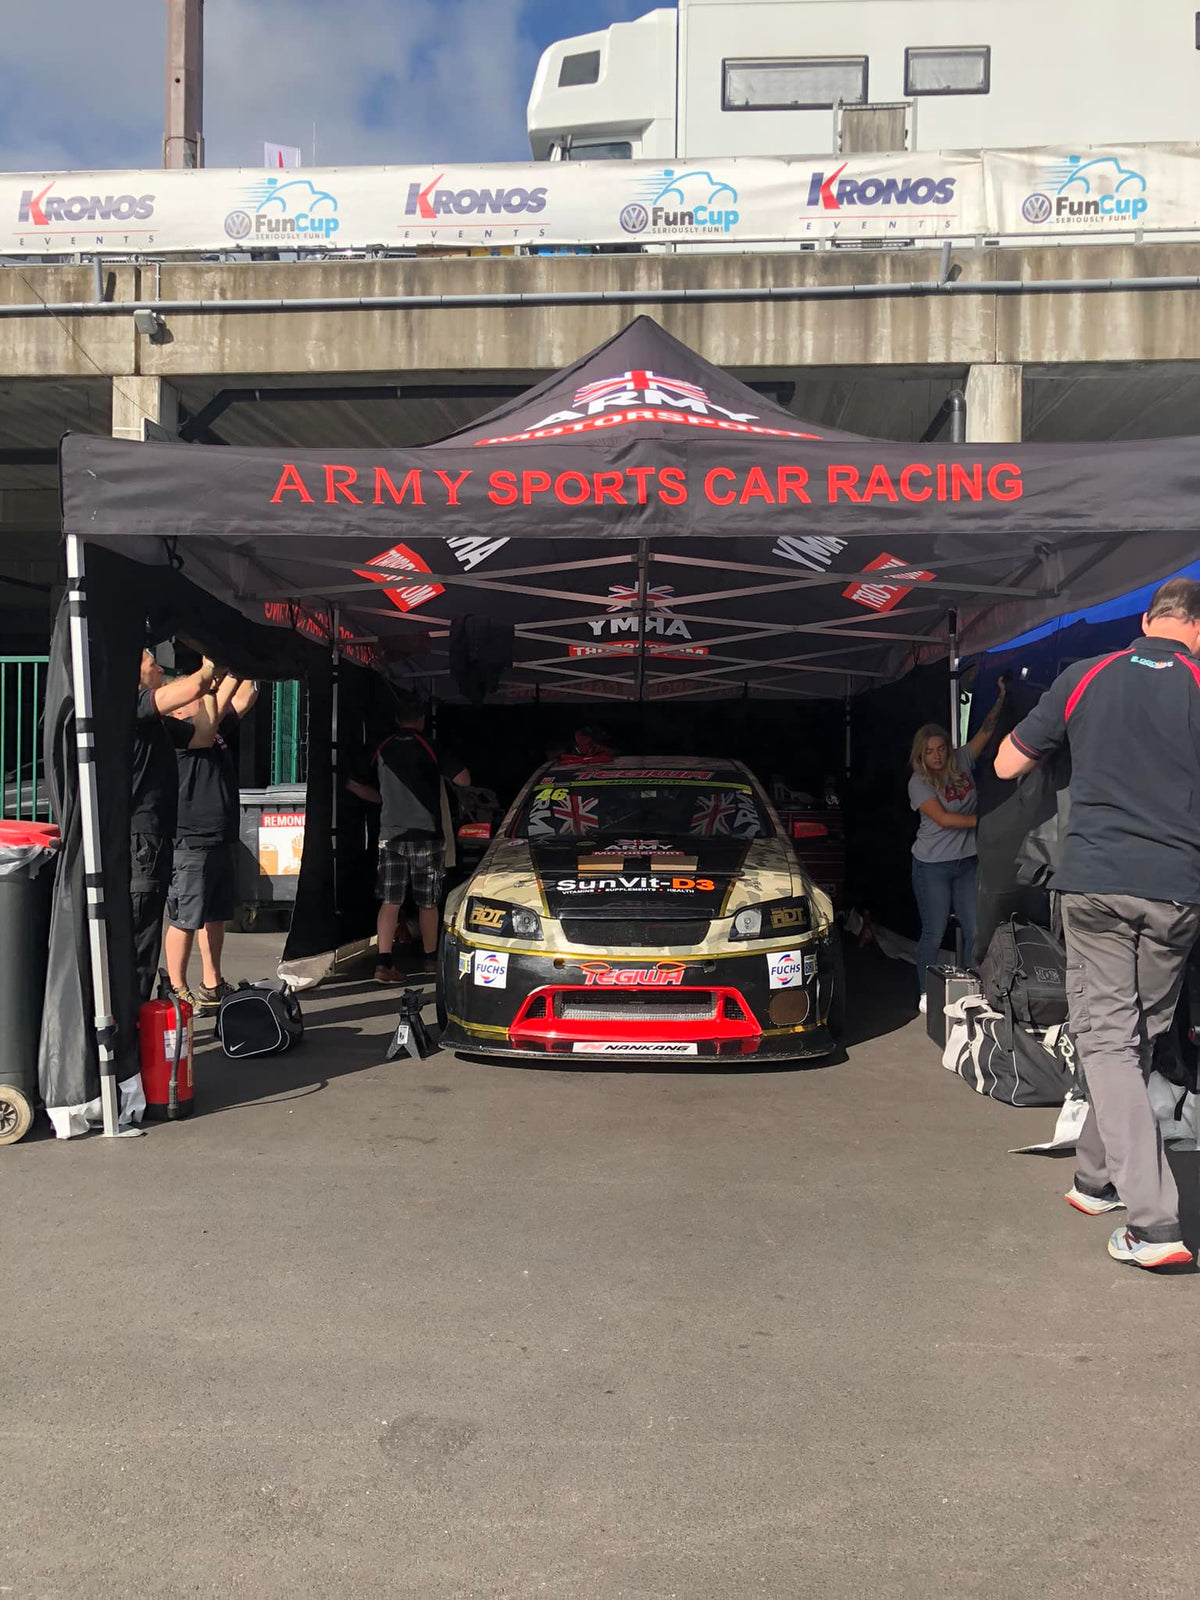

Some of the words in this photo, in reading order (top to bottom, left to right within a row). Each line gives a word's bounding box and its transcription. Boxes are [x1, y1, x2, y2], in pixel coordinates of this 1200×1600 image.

[404, 173, 548, 218] KRONOS
[806, 162, 956, 210] KRONOS
[18, 181, 155, 225] KRONOS
[1055, 195, 1148, 221] FunCup
[255, 213, 340, 238] FunCup
[652, 205, 739, 232] FunCup
[1055, 216, 1105, 224] SERIOUSLY
[1108, 214, 1131, 222] FUN!
[255, 232, 301, 240] SERIOUSLY
[303, 231, 324, 239] FUN!
[651, 226, 700, 234] SERIOUSLY
[524, 389, 760, 432] ARMY
[270, 464, 473, 505] ARMY
[488, 467, 688, 506] SPORTS
[703, 466, 812, 504] CAR
[828, 463, 1024, 502] RACING
[535, 788, 569, 801] 46
[556, 877, 715, 891] SunVit-D3
[475, 963, 506, 975] FUCHS
[582, 968, 685, 985] TEGIWA
[770, 963, 801, 976] FUCHS
